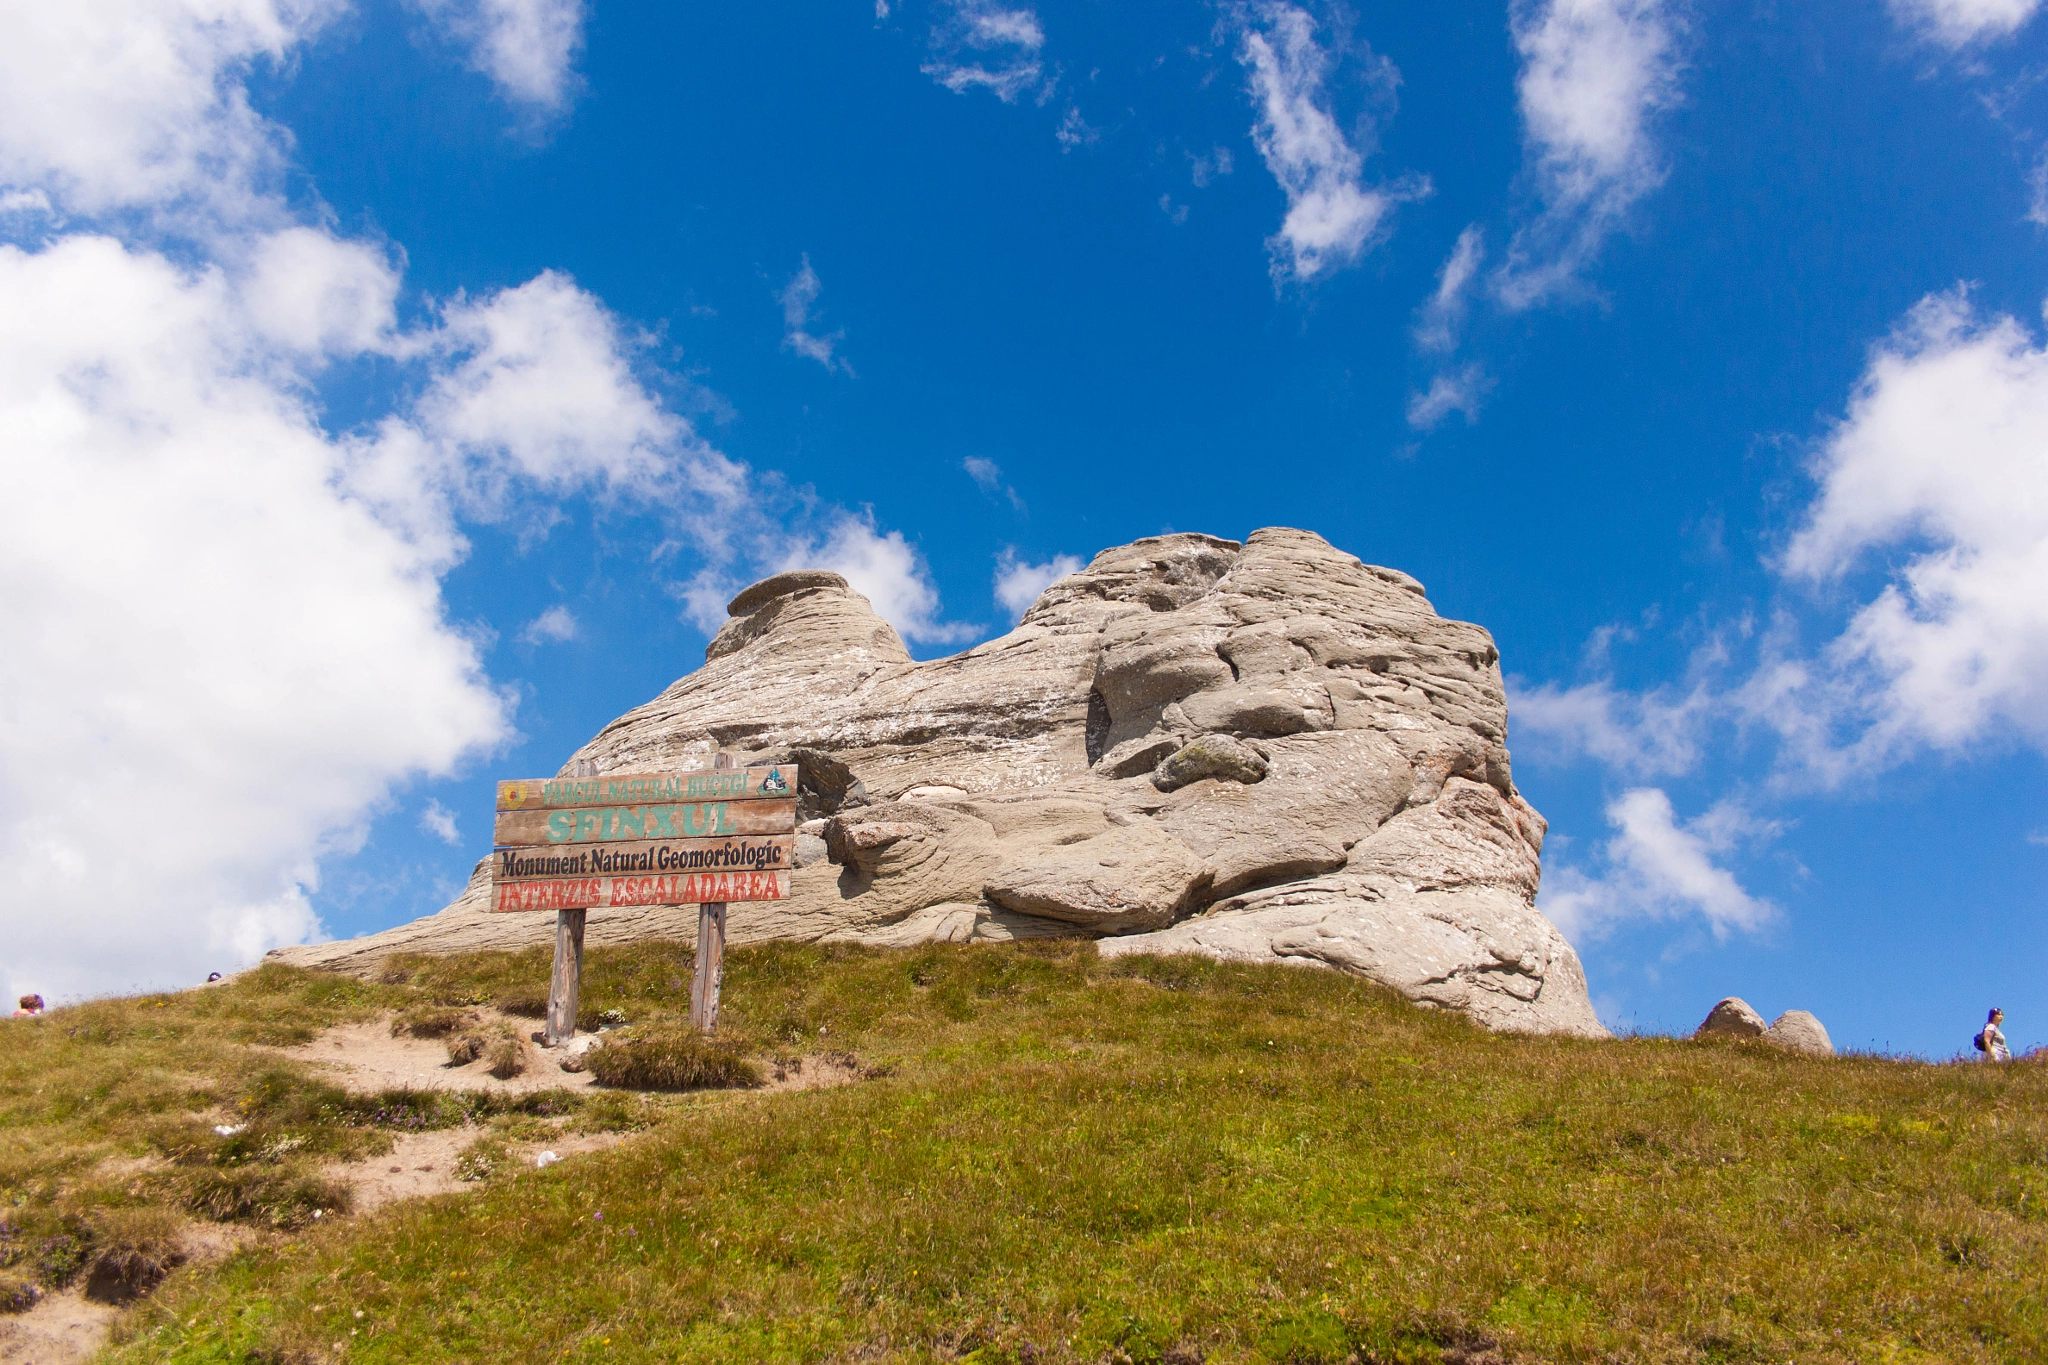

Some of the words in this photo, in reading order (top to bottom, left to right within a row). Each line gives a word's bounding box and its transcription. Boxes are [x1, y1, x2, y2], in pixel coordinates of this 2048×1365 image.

[543, 782, 603, 804] PARCUL
[607, 776, 683, 802] NATURAL
[687, 774, 748, 797] BUCEGI
[546, 803, 737, 843] SFINXUL
[501, 851, 588, 877] Monument
[591, 846, 655, 874] Natural
[657, 840, 781, 870] Geomorfologic
[499, 877, 602, 910] INTERZIS
[609, 871, 781, 906] ESCALADAREA
